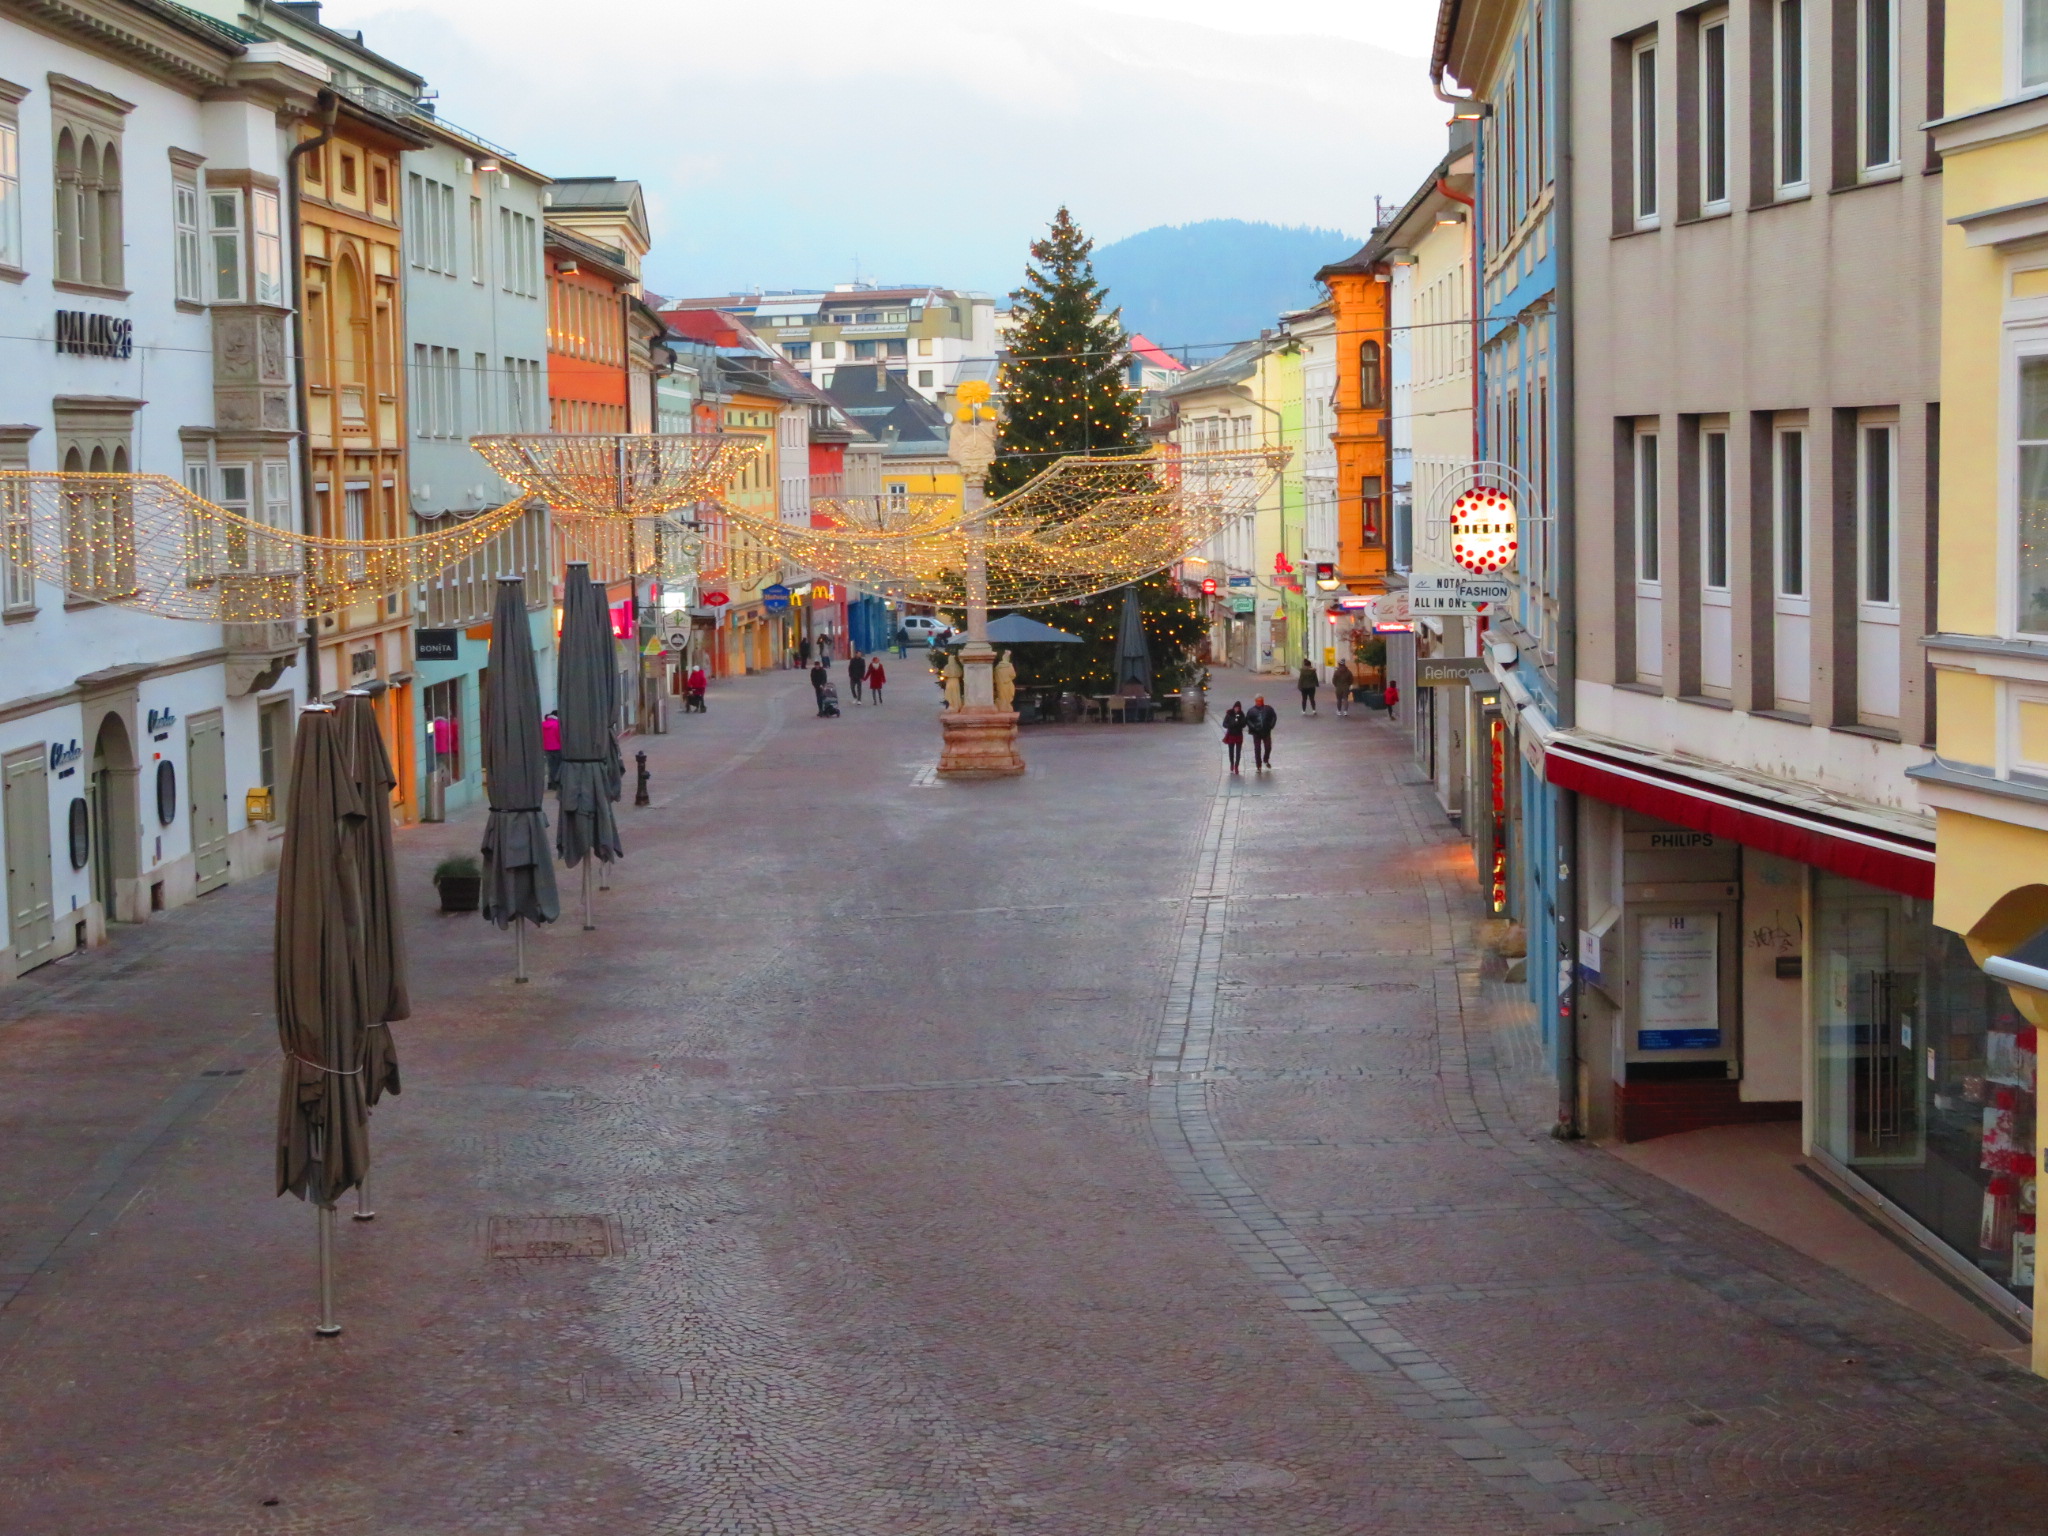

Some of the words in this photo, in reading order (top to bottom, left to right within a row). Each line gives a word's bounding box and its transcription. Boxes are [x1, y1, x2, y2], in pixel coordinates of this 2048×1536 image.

[1453, 524, 1515, 534] RIEDER
[1460, 587, 1508, 596] FASHION
[1415, 598, 1430, 607] ALL
[1435, 598, 1444, 607] IN
[1449, 598, 1467, 607] ONE
[1651, 833, 1713, 847] PHILIPS
